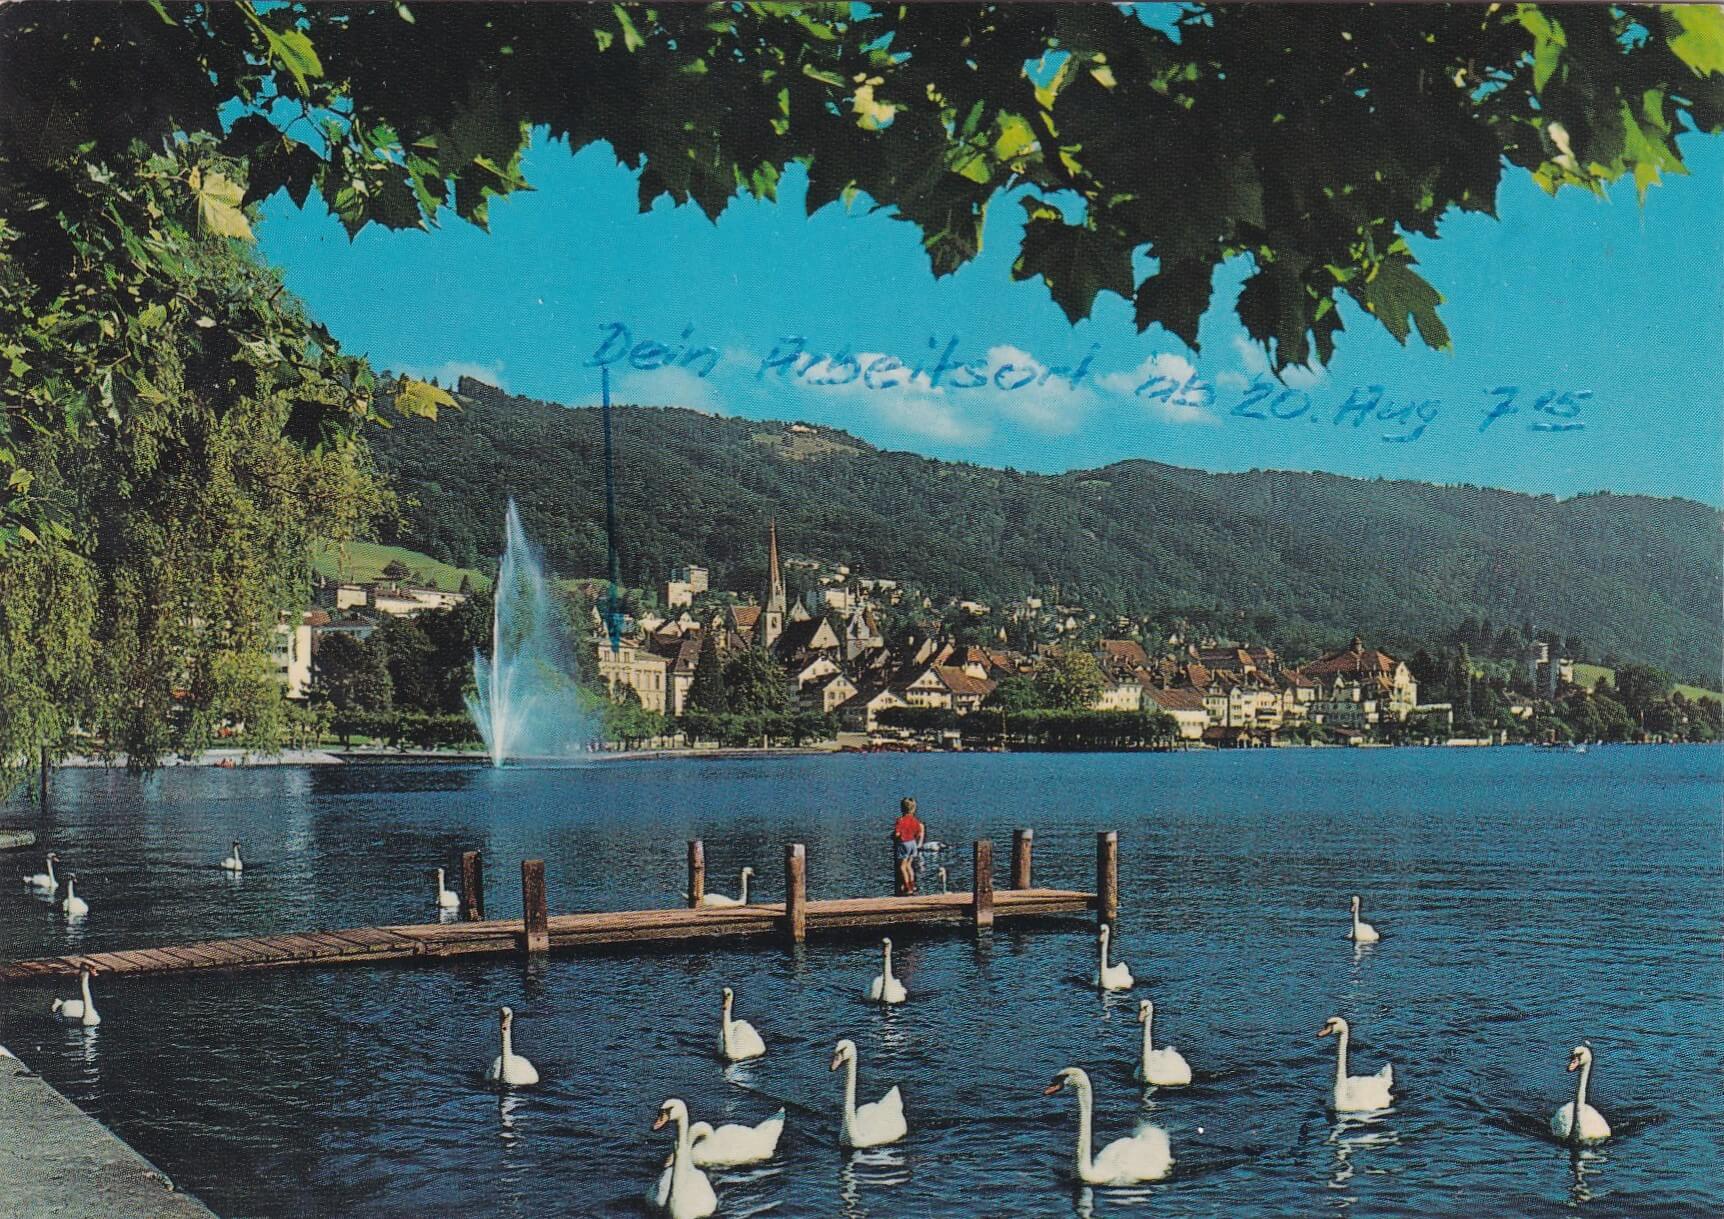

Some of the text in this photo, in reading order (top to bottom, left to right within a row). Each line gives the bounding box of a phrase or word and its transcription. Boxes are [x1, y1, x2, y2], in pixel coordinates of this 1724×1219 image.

[583, 321, 720, 378] Dein
[1135, 373, 1218, 408] ab
[1230, 379, 1319, 420] 20.
